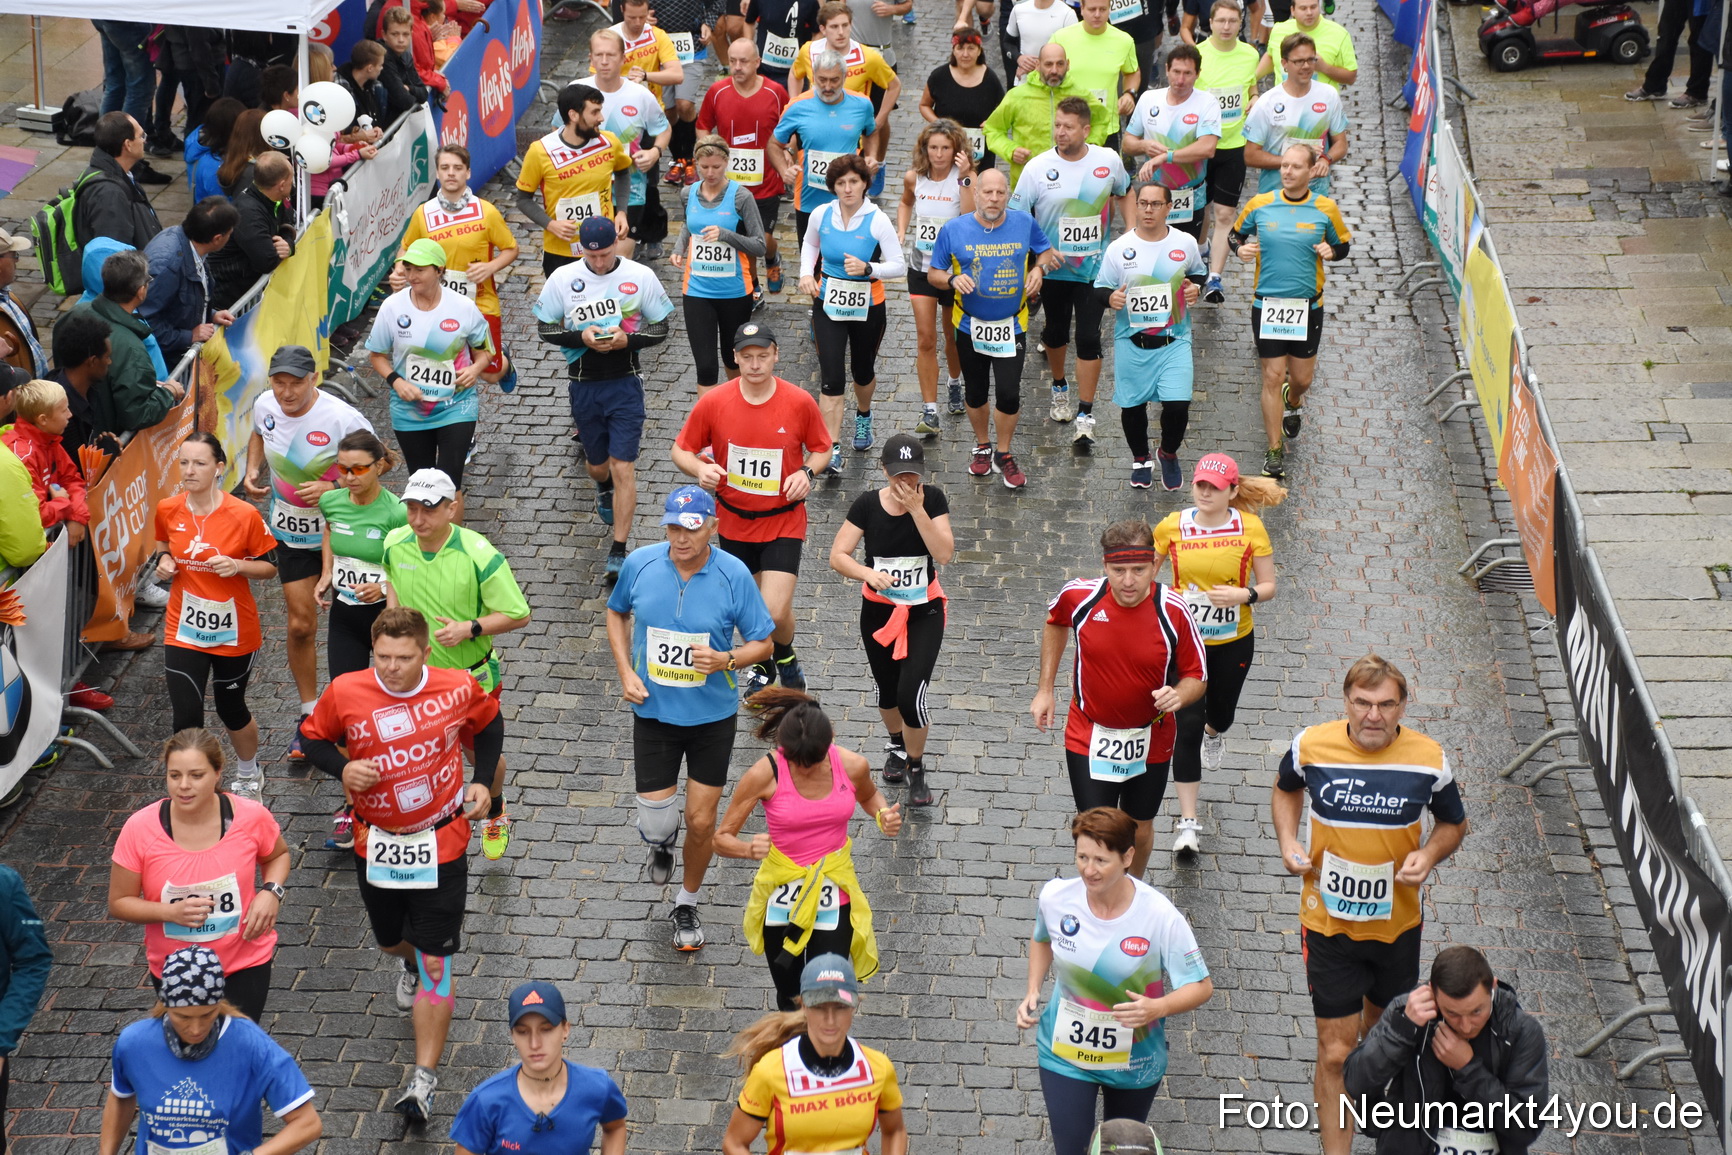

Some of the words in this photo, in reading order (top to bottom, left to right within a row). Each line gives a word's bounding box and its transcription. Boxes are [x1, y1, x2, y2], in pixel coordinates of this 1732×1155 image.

[1117, 9, 1134, 19] Jochen
[637, 46, 659, 58] BÖGL
[767, 42, 797, 58] 2667
[772, 57, 788, 65] Stefan
[845, 67, 867, 78] ÖGL
[479, 56, 512, 120] Hervis
[558, 163, 586, 181] MAX
[587, 151, 615, 169] BÖGL
[732, 157, 756, 172] 233
[565, 203, 594, 221] 294
[429, 230, 454, 243] MAX
[456, 223, 486, 236] BÖGL
[1063, 226, 1098, 242] 2044
[695, 245, 732, 262] 2584
[974, 249, 1015, 257] STADTLAUF
[976, 242, 1023, 251] NEUMARKTER
[701, 264, 724, 272] Kristina
[829, 288, 867, 307] 2585
[1130, 295, 1169, 312] 2524
[575, 299, 617, 321] 3109
[835, 308, 855, 317] Margit
[1266, 307, 1304, 324] 2427
[975, 325, 1011, 342] 2038
[1272, 326, 1296, 335] Norbert
[983, 344, 1004, 352] Norbert
[410, 365, 453, 386] 2440
[309, 433, 328, 444] Hervis
[738, 458, 771, 478] 116
[1200, 460, 1228, 475] NIKE
[741, 479, 763, 489] Alfred
[276, 511, 320, 533] 2651
[290, 535, 307, 543] Toni
[1181, 541, 1208, 551] MAX
[1213, 538, 1245, 549] BÖGL
[185, 606, 232, 630] 2694
[1189, 603, 1236, 623] 2746
[195, 632, 217, 642] Karin
[1200, 626, 1220, 635] Katja
[658, 643, 694, 667] 320
[656, 668, 694, 682] Wolfgang
[375, 707, 406, 719] raumbox
[1096, 738, 1145, 761] 2205
[1112, 764, 1129, 774] Max
[1334, 788, 1408, 808] Fischer
[1340, 804, 1403, 815] AUTOMOBILE
[374, 842, 431, 865] 2355
[390, 870, 415, 880] Claus
[1327, 871, 1387, 900] 3000
[776, 883, 833, 907] 243
[1337, 898, 1378, 916] OTTO
[1124, 940, 1149, 951] Hervis
[1069, 1020, 1117, 1050] 345
[1077, 1050, 1104, 1062] Petra
[789, 1099, 829, 1115] MAX
[835, 1091, 876, 1108] BÖGL
[154, 1115, 200, 1123] Neumarkter
[501, 1139, 521, 1151] Nick
